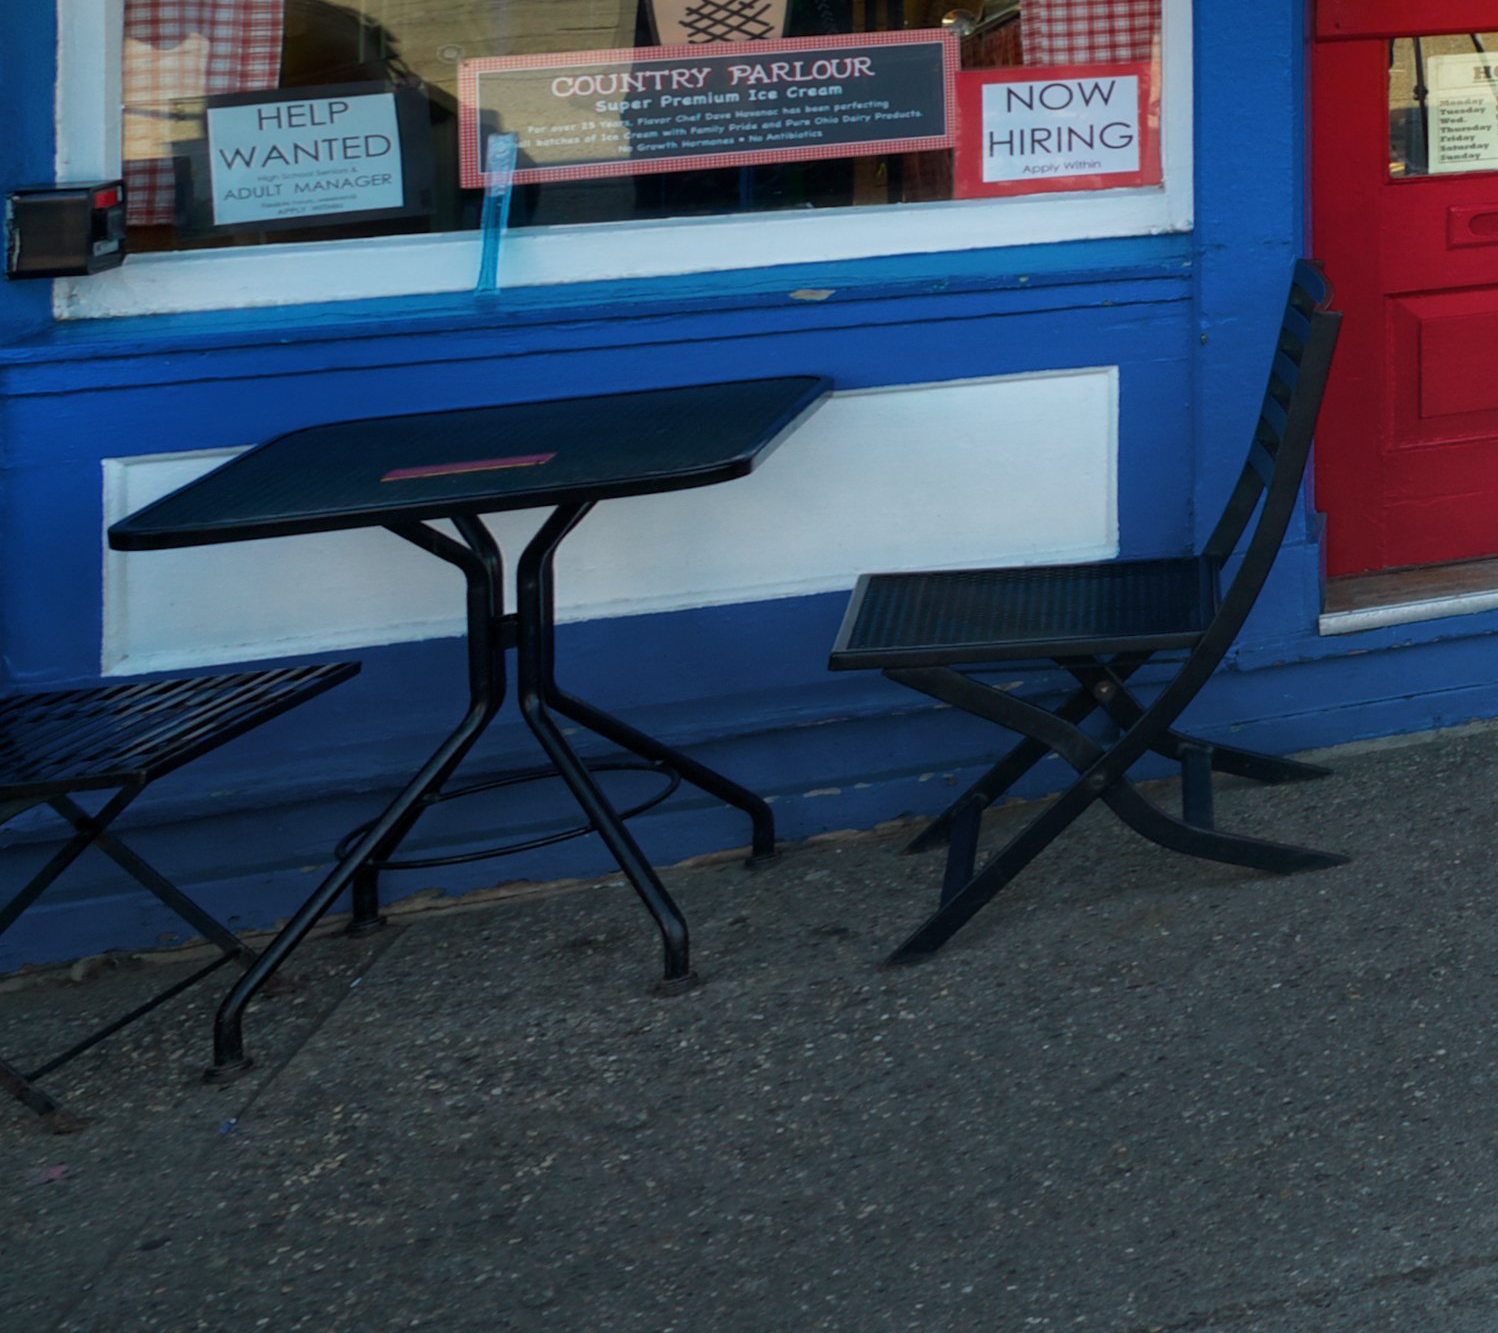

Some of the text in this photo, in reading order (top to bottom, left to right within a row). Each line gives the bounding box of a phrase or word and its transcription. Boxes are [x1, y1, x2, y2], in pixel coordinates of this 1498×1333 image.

[552, 57, 875, 97] COUNTRY PARLOUR
[595, 85, 843, 114] Super Premium Ice Cream
[1006, 80, 1116, 113] NOW
[1440, 98, 1484, 107] Monday
[257, 101, 349, 131] HELP
[528, 125, 546, 134] For
[551, 125, 576, 133] over
[637, 116, 672, 126] Flavor
[675, 113, 701, 123] Chef
[706, 111, 731, 120] Dave
[783, 106, 801, 115] has
[805, 104, 830, 113] been
[834, 100, 889, 113] perfecting
[1440, 106, 1486, 115] Tuesday
[536, 136, 580, 147] batches
[584, 135, 597, 144] of
[601, 133, 619, 142] Ice
[623, 130, 659, 140] Cream
[663, 128, 688, 138] with
[690, 121, 724, 135] Family
[729, 121, 758, 132] Pride
[762, 119, 782, 129] and
[785, 118, 811, 128] Pure
[815, 116, 839, 125] Ohio
[842, 113, 871, 125] Dairy
[618, 129, 823, 153] No Growth Hormones No Antibiotics
[989, 122, 1134, 157] HIRING
[1440, 124, 1492, 133] Thursday
[1440, 134, 1476, 143] Friday
[219, 134, 392, 170] WANTED
[1440, 142, 1490, 152] Saturday
[1440, 152, 1481, 161] Sunday
[257, 173, 279, 183] High
[1022, 159, 1102, 175] Apply Within
[224, 184, 283, 201] ADULT
[294, 173, 393, 194] MANAGER
